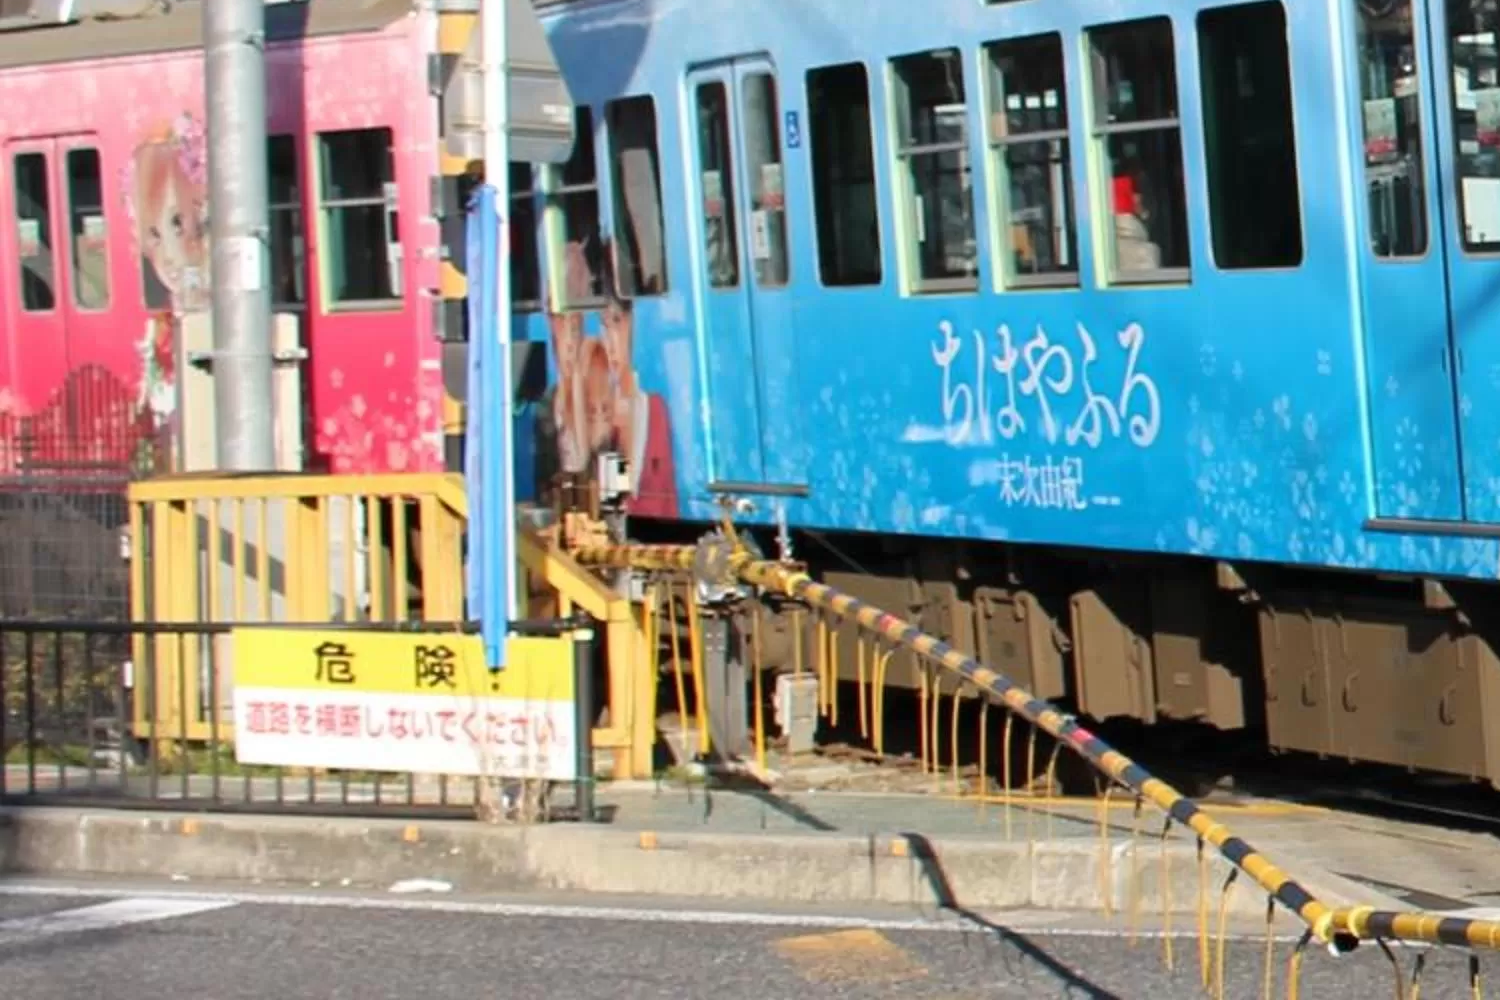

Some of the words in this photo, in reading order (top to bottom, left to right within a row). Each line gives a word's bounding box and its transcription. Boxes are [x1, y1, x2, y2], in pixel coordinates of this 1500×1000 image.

[930, 319, 1161, 448] ちはやふる
